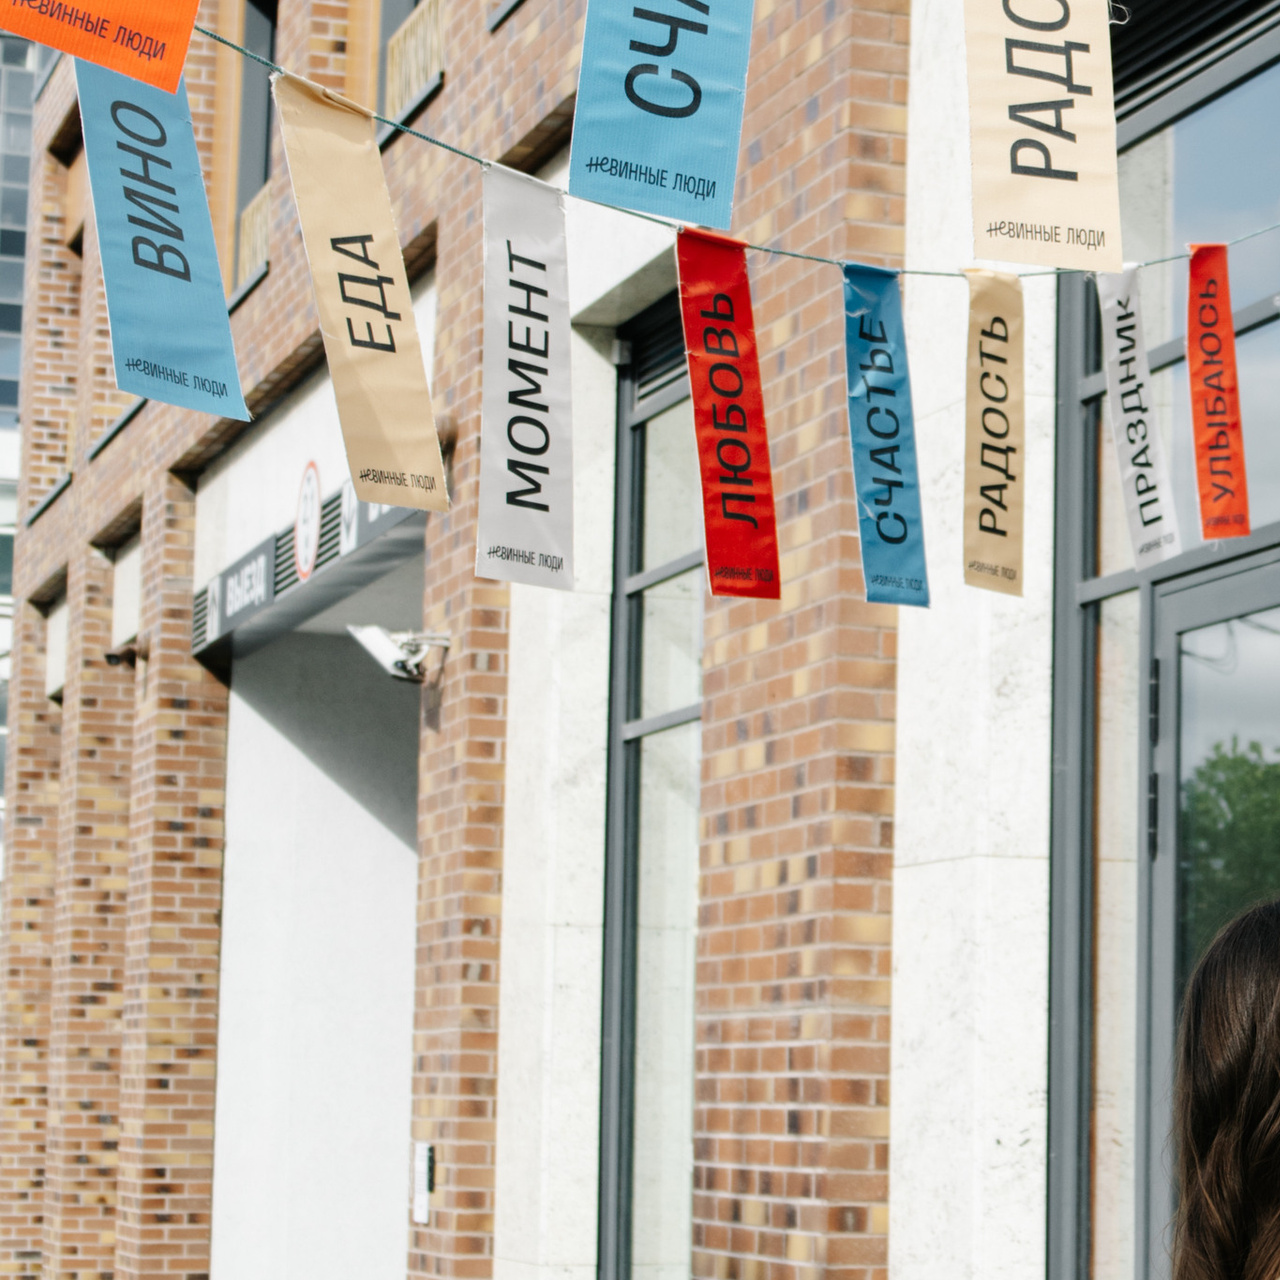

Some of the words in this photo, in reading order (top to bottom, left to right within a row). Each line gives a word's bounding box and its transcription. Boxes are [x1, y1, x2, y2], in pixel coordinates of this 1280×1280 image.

[114, 24, 167, 62] ЛЮДИ
[110, 100, 192, 283] ВИНО
[672, 171, 718, 202] ЛЮДИ
[1066, 227, 1107, 251] ЛЮДИ
[329, 233, 401, 354] ЕДА
[193, 375, 229, 399] ЛЮДИ
[506, 238, 551, 513] МОМЕНТ
[700, 292, 759, 530] ЛЮБОВЬ
[858, 314, 909, 545] СЧАСТЬЕ
[978, 316, 1017, 538] РАДОСТЬ
[1116, 295, 1163, 528] ПРАЗДНИК
[1199, 277, 1235, 503] УЛЫБАЮСЬ
[410, 473, 437, 494] ЛЮДИ
[225, 552, 267, 618] ВЫЕЗД
[538, 552, 565, 571] ЛЮДИ
